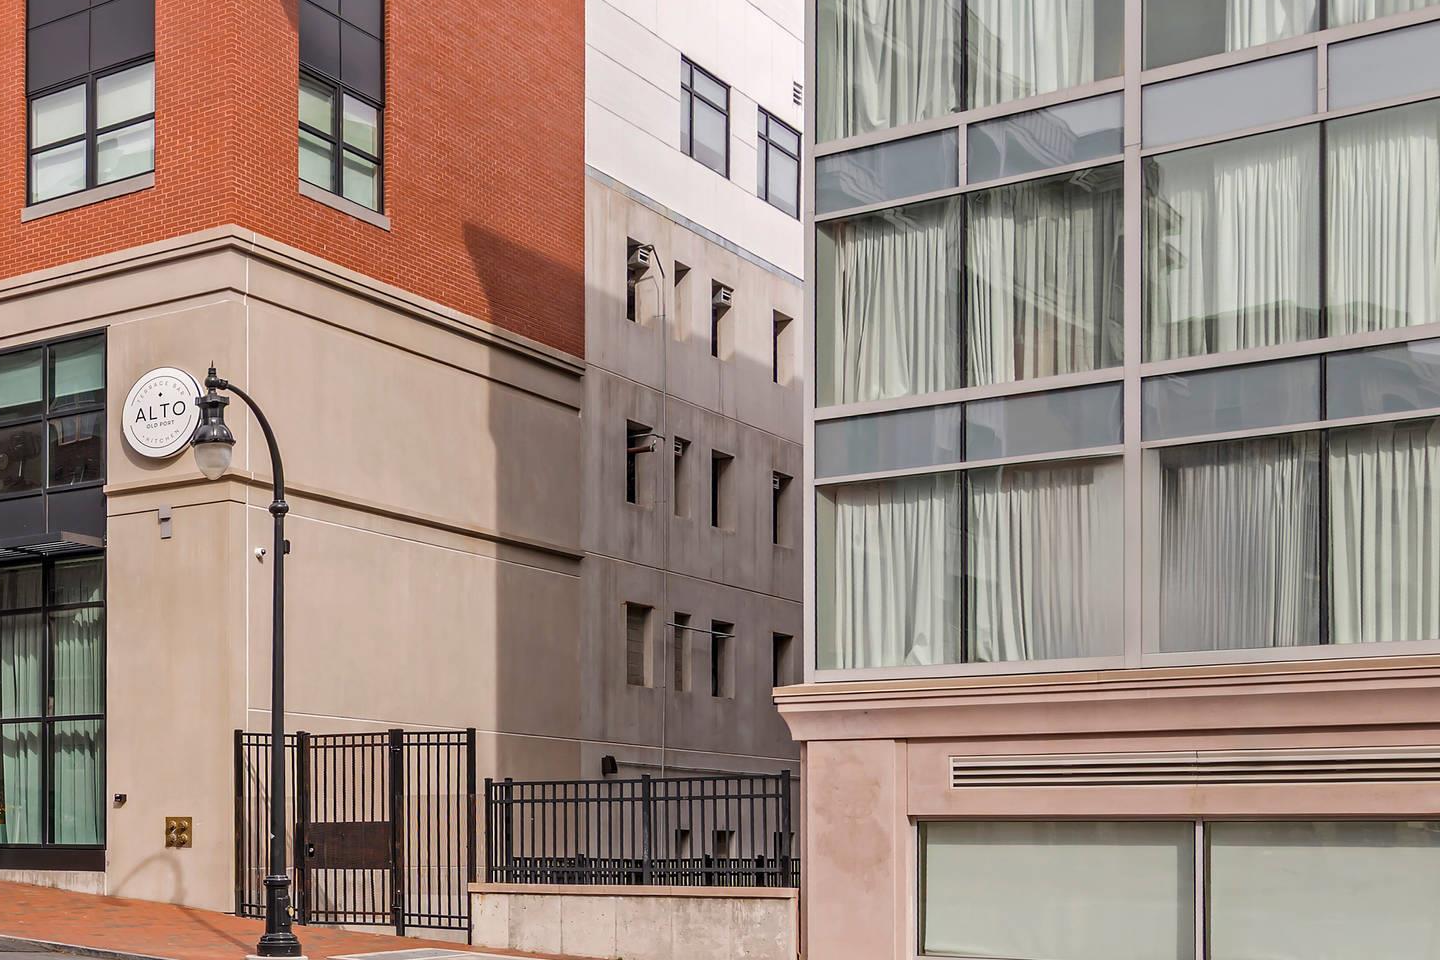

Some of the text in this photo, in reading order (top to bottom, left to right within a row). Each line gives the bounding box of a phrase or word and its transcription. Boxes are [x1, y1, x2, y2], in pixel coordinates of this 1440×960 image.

[137, 380, 185, 403] TERRACE BAR
[135, 400, 186, 423] ALTO
